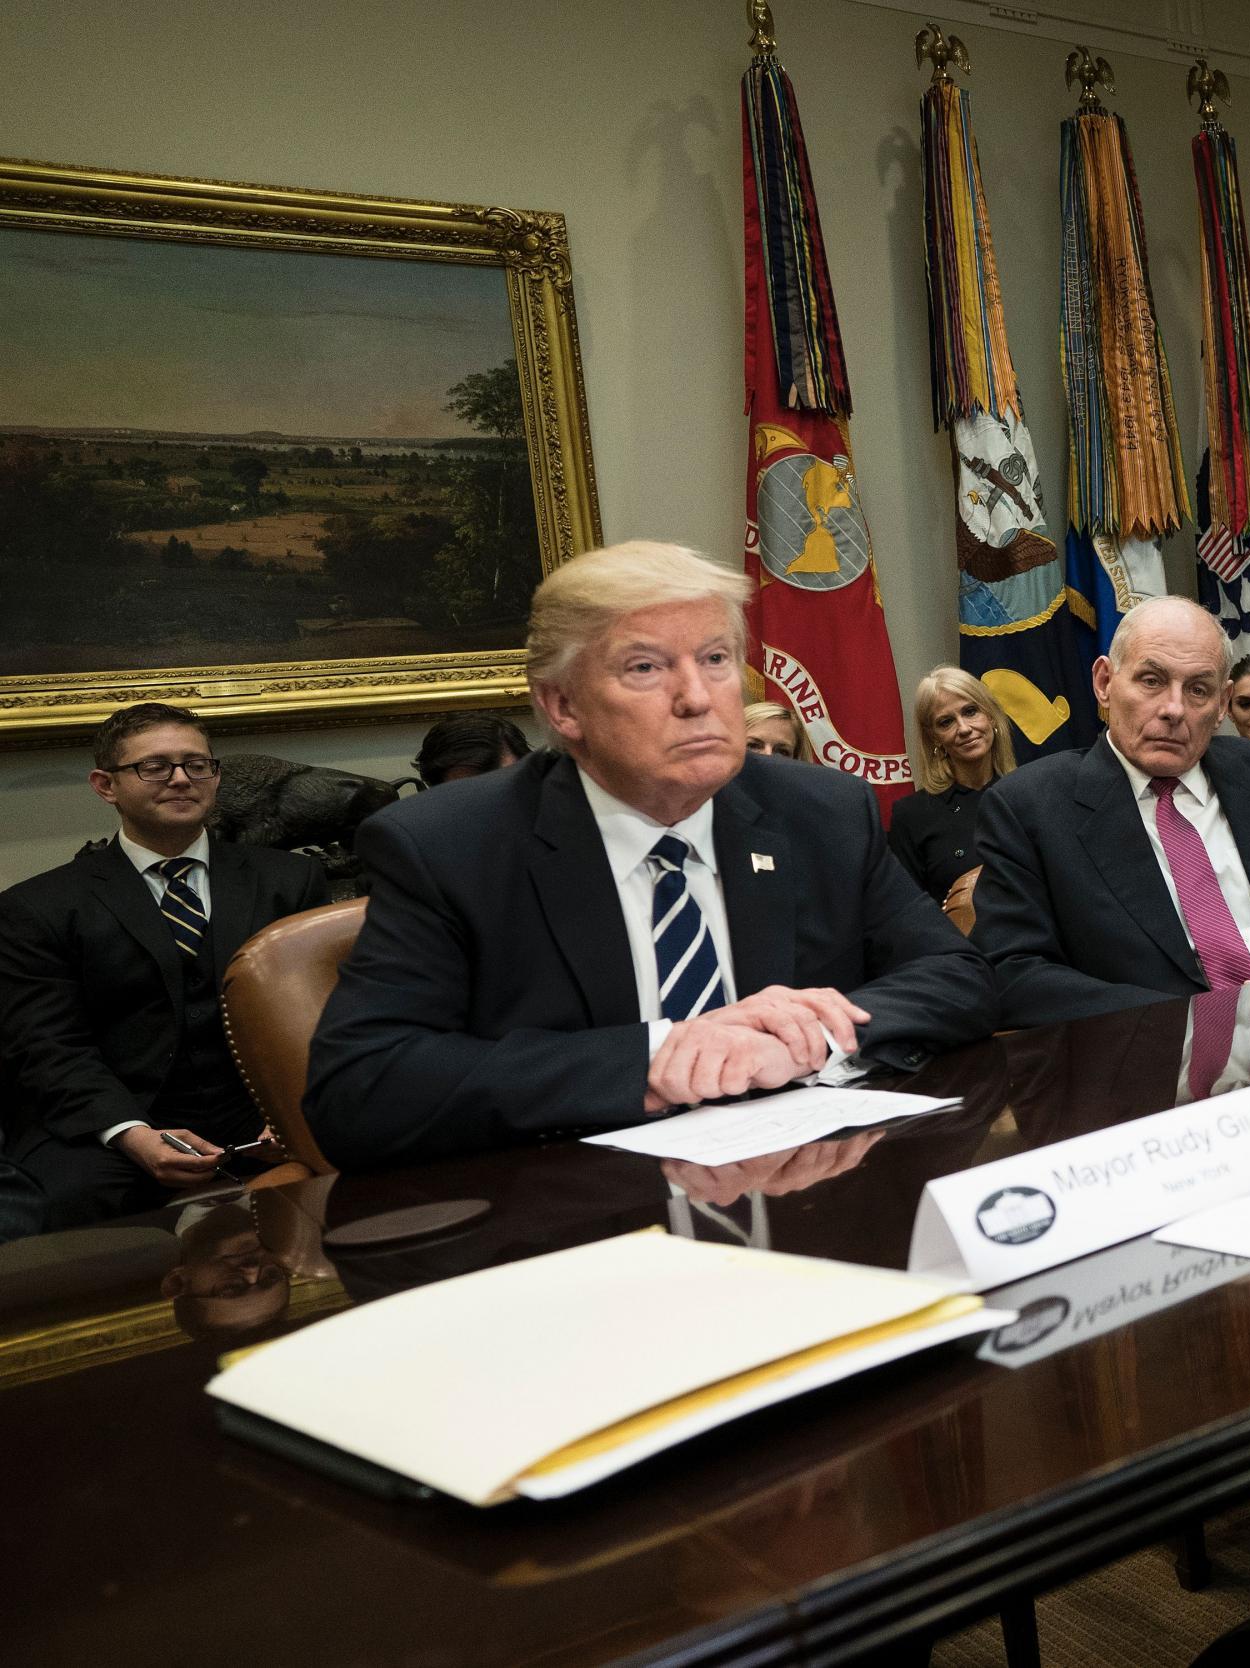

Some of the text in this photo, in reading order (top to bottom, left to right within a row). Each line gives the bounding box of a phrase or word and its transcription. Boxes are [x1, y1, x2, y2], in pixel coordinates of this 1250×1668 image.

[1081, 259, 1096, 379] GRENADA 1983
[1116, 256, 1131, 332] RYUKYUS
[1120, 367, 1137, 449] 1943-1944
[764, 648, 912, 781] RINE CORPS
[1051, 1152, 1137, 1194] Mayor
[1141, 1126, 1212, 1164] Rudy
[1161, 1163, 1231, 1194] New York
